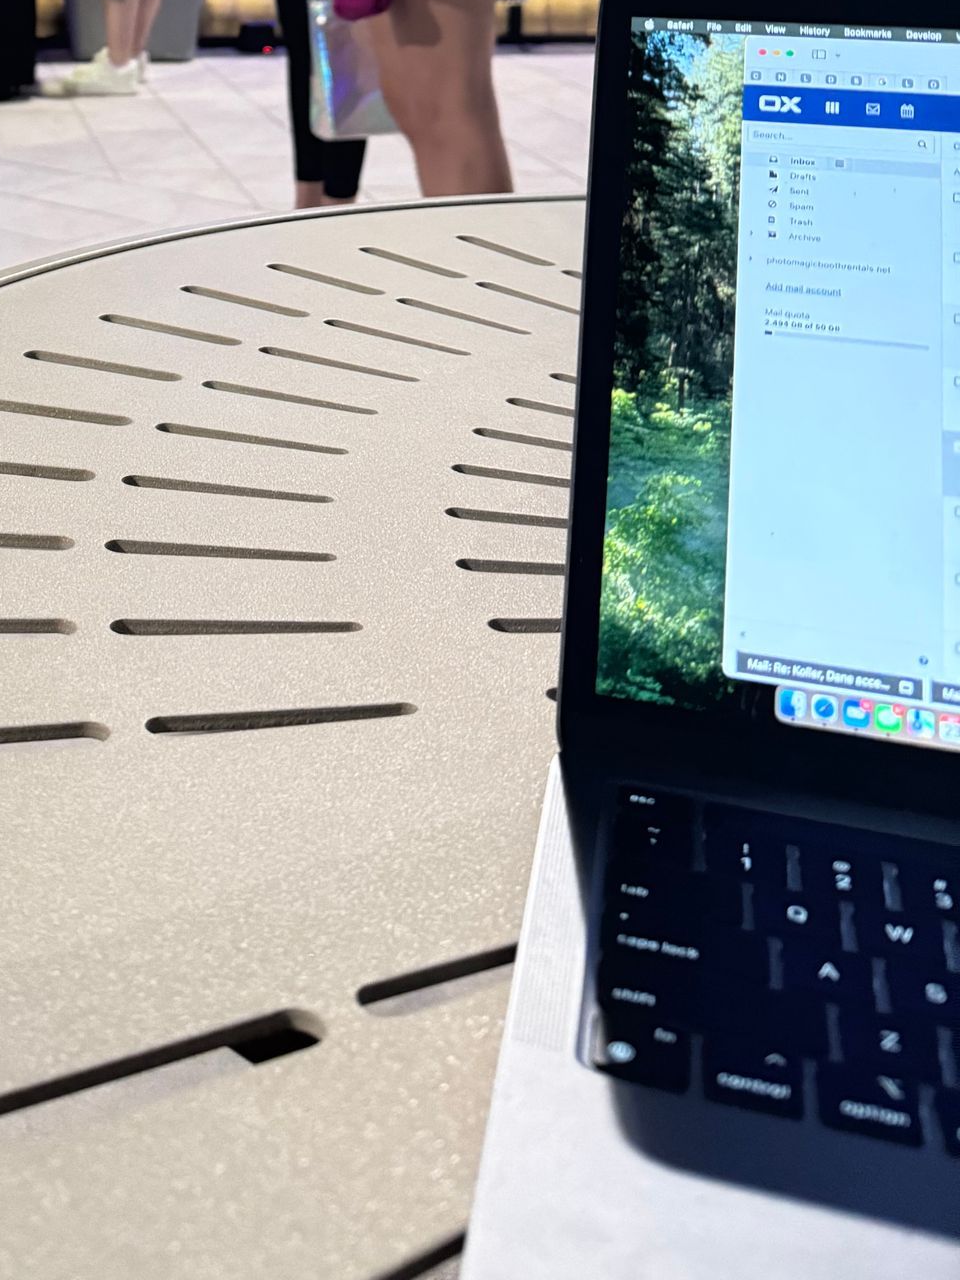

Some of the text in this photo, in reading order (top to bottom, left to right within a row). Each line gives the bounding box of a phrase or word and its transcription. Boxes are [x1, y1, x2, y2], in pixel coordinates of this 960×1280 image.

[667, 21, 942, 42] Safari File Edit View History Bookmarks Develop
[758, 94, 802, 114] OX
[790, 157, 816, 166] Inbox
[790, 172, 816, 181] Drafts
[790, 187, 809, 196] Sent
[790, 202, 814, 211] Spam
[790, 217, 813, 227] Trash
[789, 233, 821, 242] Archive
[765, 282, 842, 297] Add mail account
[765, 308, 810, 320] Mail quota
[747, 658, 771, 671] Mail:
[787, 905, 808, 924] Q
[885, 923, 914, 944] W
[880, 1029, 902, 1053] Z
